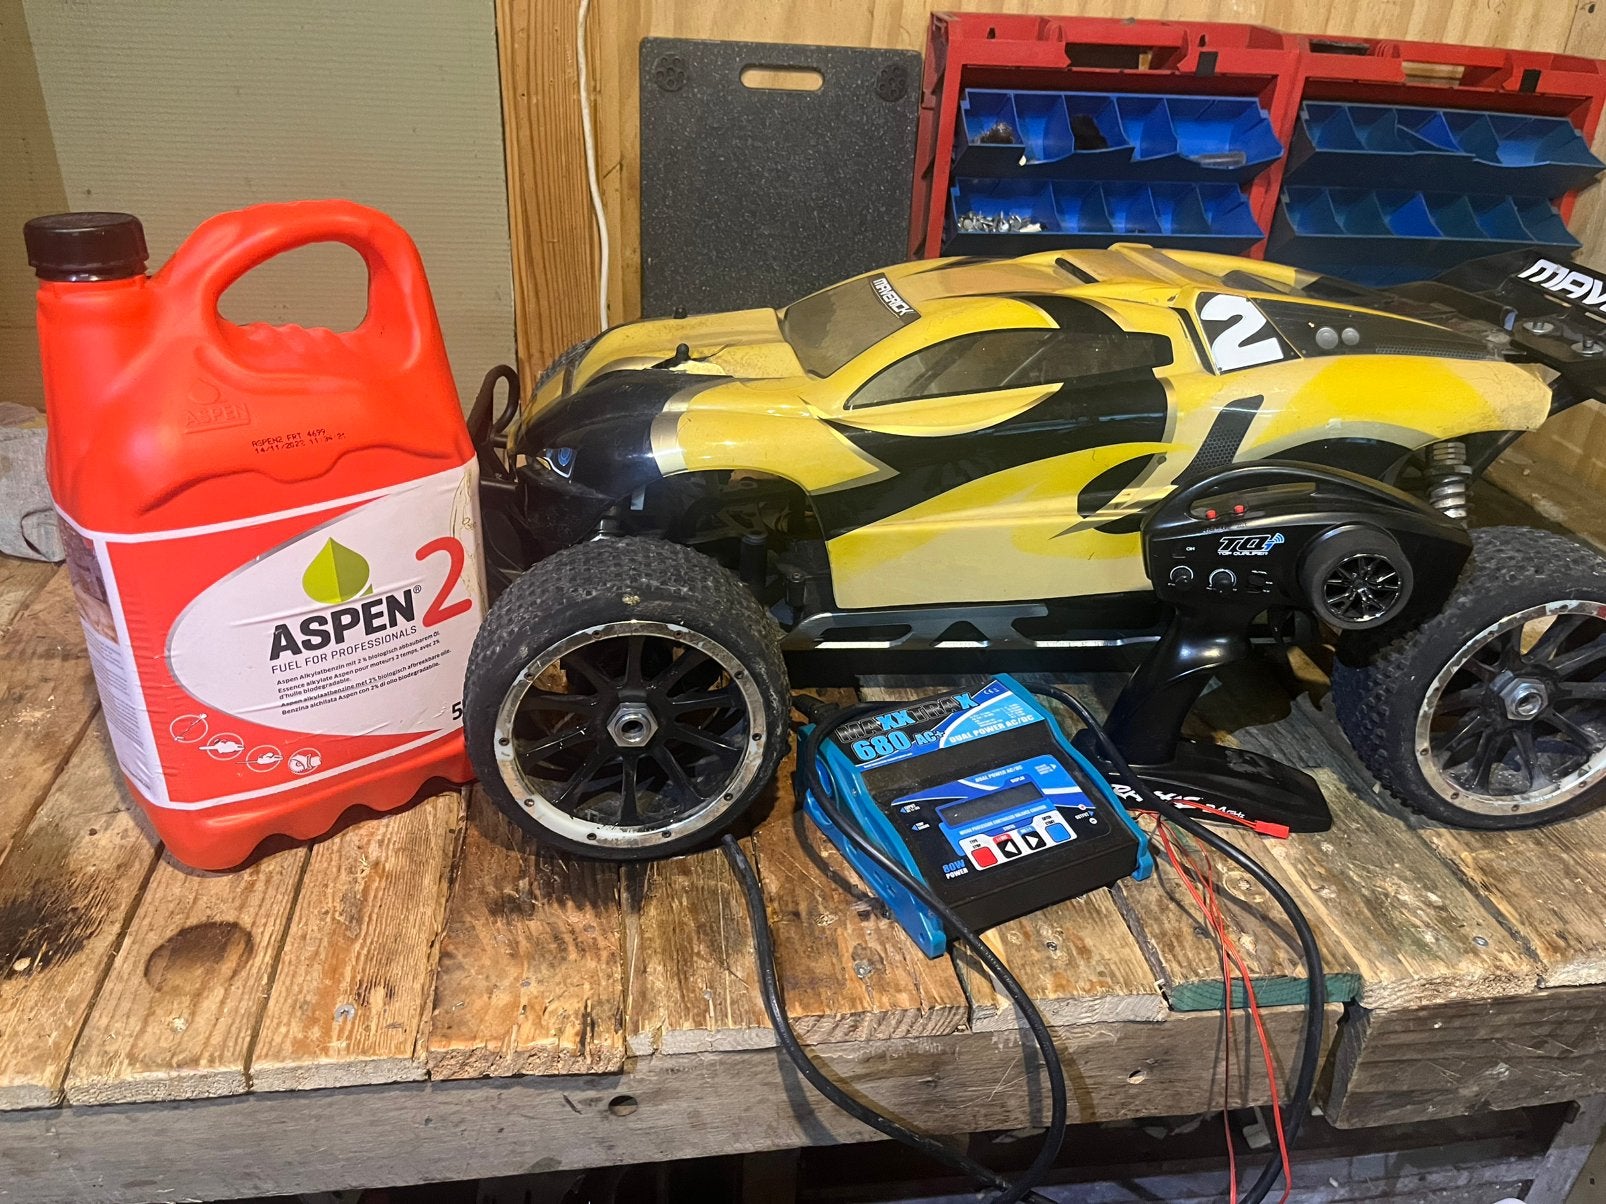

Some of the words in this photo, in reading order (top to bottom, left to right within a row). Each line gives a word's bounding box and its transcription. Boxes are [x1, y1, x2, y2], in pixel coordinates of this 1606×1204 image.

[872, 277, 915, 316] MAVERICK
[1200, 294, 1284, 372] 2
[415, 536, 473, 628] 2
[269, 588, 416, 661] ASPEN
[271, 660, 303, 675] FUEL
[304, 653, 328, 667] FOR
[331, 625, 417, 660] PROFESSIONALS
[276, 676, 299, 686] Aspen
[299, 664, 345, 680] Alkylatbenzin
[368, 645, 398, 661] biologisch
[399, 635, 433, 651] abbaubarem
[277, 683, 306, 694] Essence
[306, 676, 333, 687] alkylate
[334, 670, 354, 680] Aspen
[354, 665, 370, 674] pour
[369, 656, 395, 668] moteurs
[420, 643, 432, 651] avec
[433, 639, 440, 647] 2%
[355, 680, 368, 689] met
[368, 676, 378, 685] 2%
[377, 665, 407, 681] biologisch
[407, 653, 440, 670] afbreekbare
[440, 649, 451, 657] olie.
[281, 704, 309, 716] Benzina
[309, 696, 338, 709] alchilata
[338, 690, 358, 701] Aspen
[358, 687, 370, 695] con
[370, 683, 380, 691] 2%
[386, 678, 398, 686] olio
[398, 662, 440, 681] biodegradabile.
[303, 677, 350, 694] biodegradable.
[834, 692, 980, 744] MAXXTRAX
[949, 730, 977, 744] DUAL
[977, 723, 1005, 738] POWER
[1005, 715, 1035, 730] AC/DC
[851, 731, 914, 762] 680
[914, 729, 946, 746] AC+
[942, 859, 966, 873] 80W
[945, 868, 969, 880] POWER
